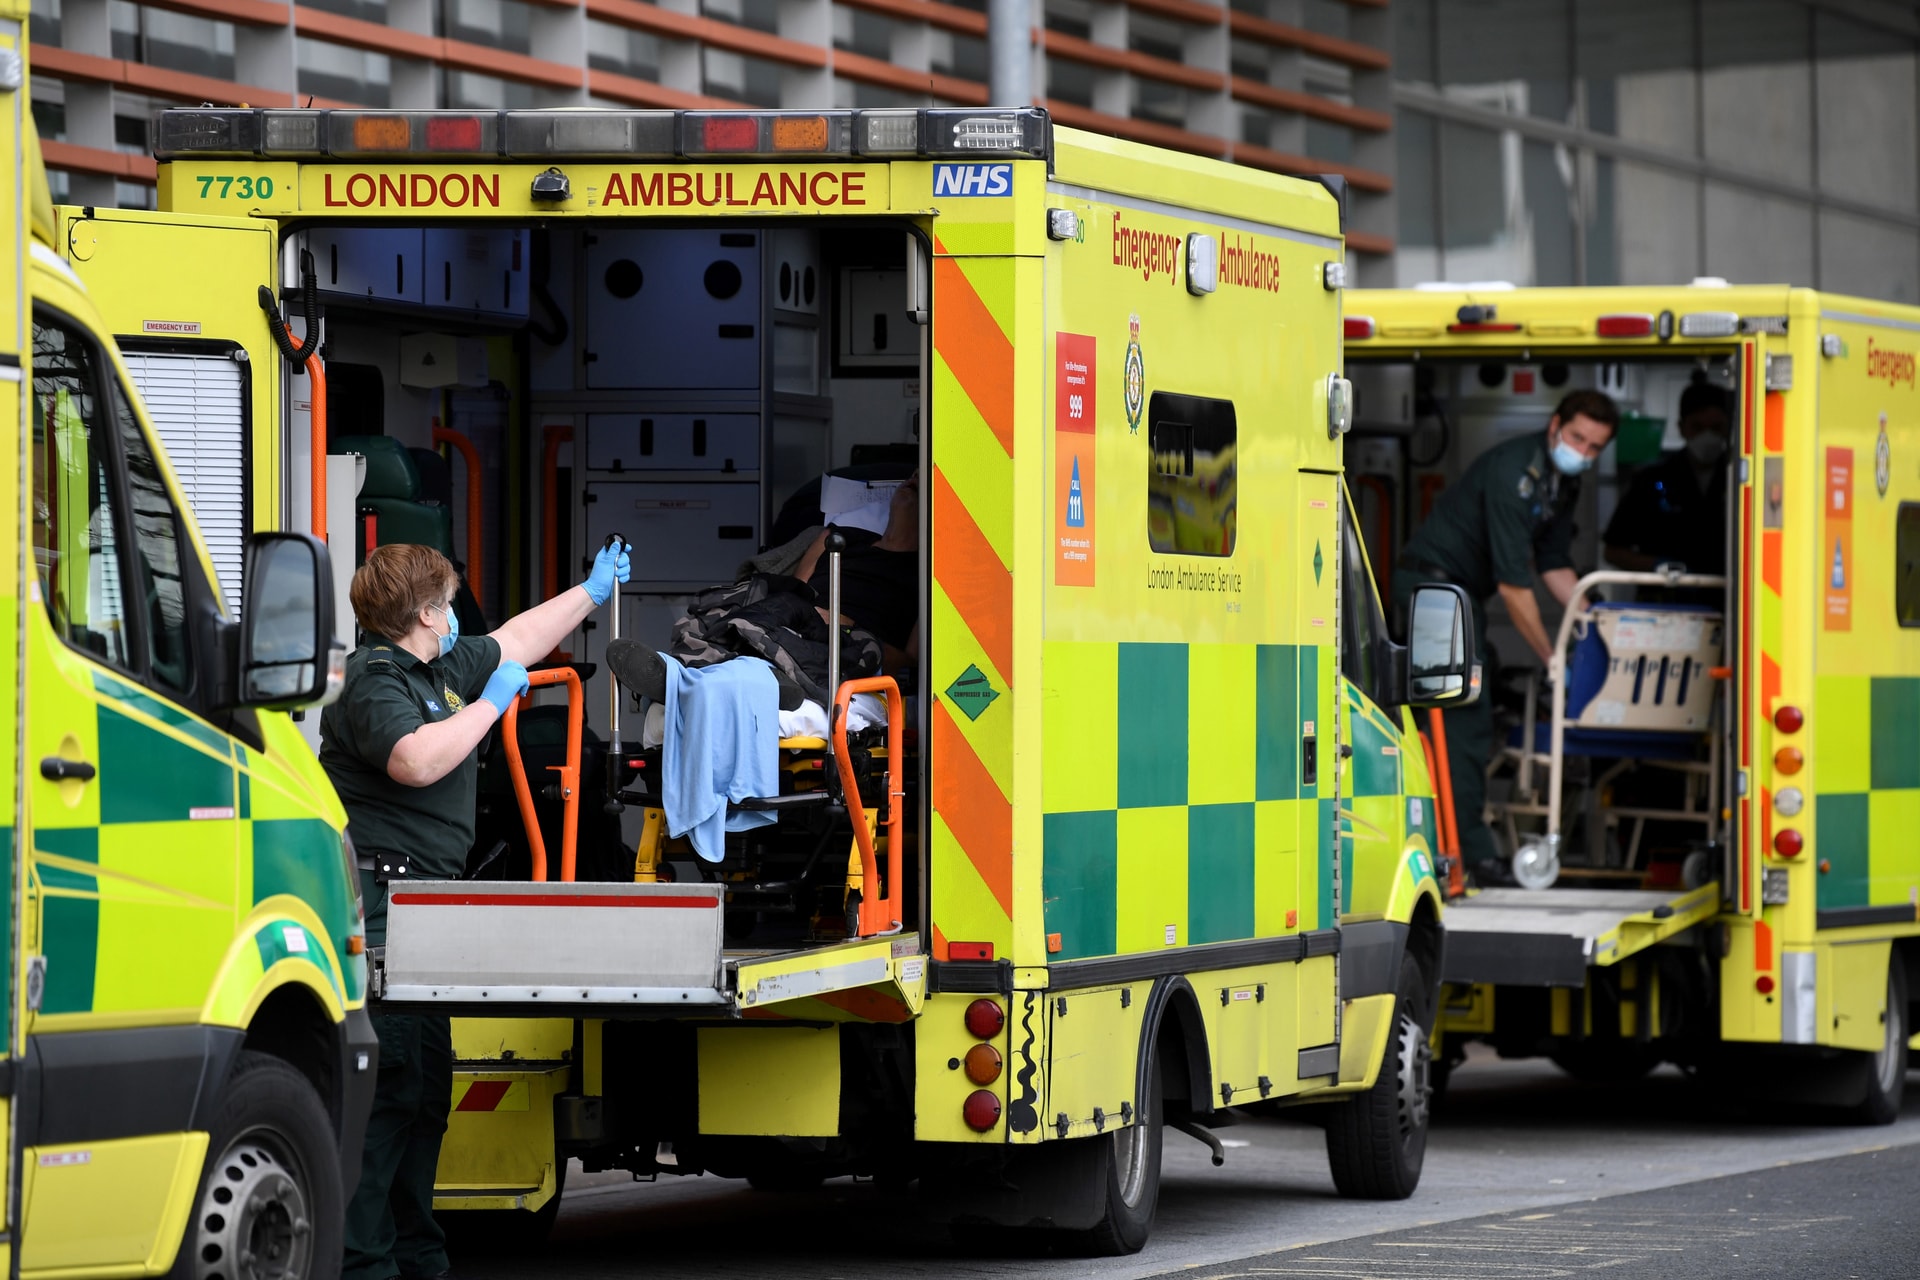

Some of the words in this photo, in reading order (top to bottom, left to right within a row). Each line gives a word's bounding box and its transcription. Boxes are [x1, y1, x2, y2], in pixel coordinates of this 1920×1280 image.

[196, 175, 274, 199] 7730
[324, 173, 500, 207] LONDON
[601, 171, 866, 206] AMBULANCE
[935, 165, 1010, 195] NHS
[1112, 211, 1182, 286] Emergency
[1219, 231, 1280, 294] Ambulance
[146, 323, 182, 331] EMERGENCY
[1867, 336, 1916, 391] Emergency
[1070, 394, 1082, 418] 999
[1070, 496, 1080, 520] 111
[1147, 562, 1174, 590] London
[1177, 563, 1216, 592] Ambulance
[1217, 565, 1242, 593] Service
